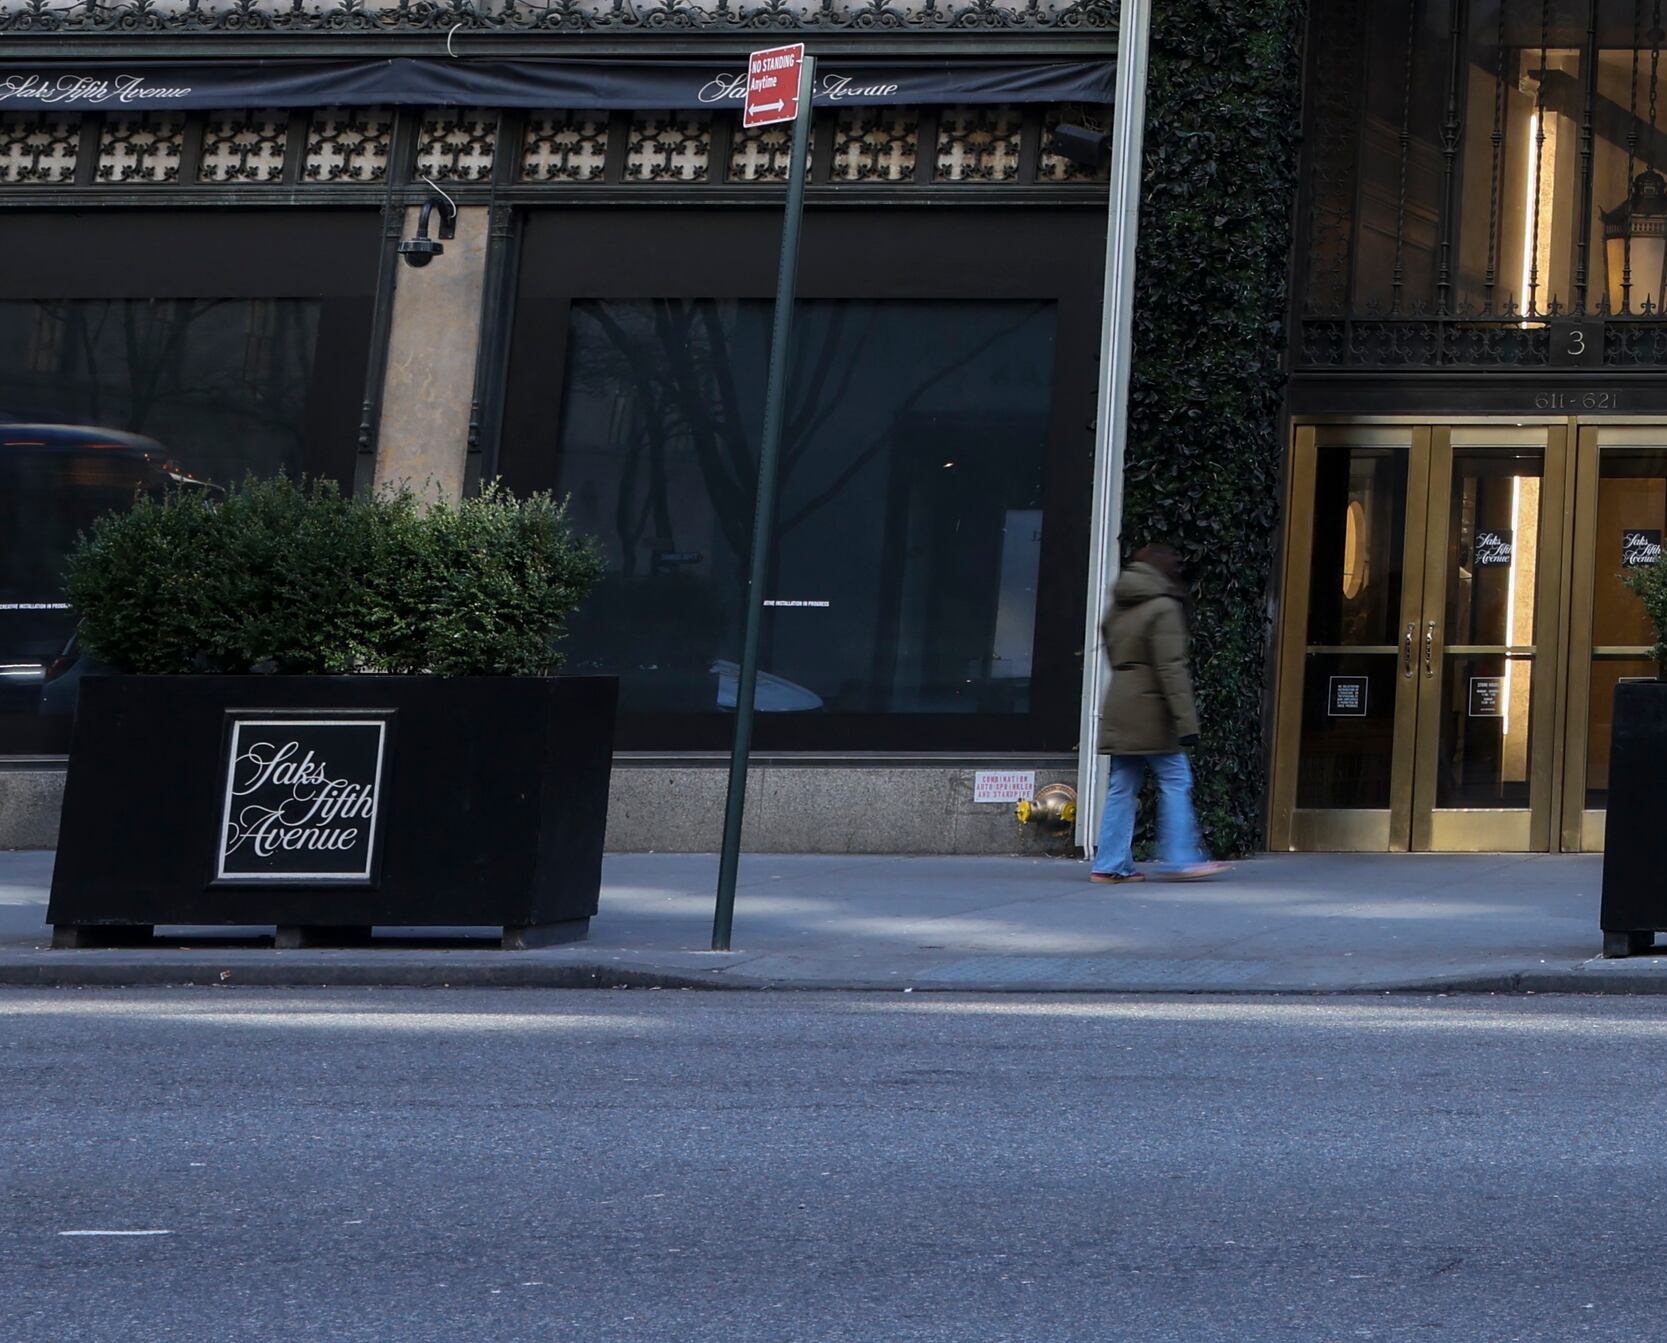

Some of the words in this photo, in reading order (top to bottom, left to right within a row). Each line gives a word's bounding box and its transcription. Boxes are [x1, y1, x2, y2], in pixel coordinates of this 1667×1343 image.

[751, 60, 762, 74] NO
[762, 54, 795, 72] STANDING
[0, 74, 56, 102] Saks
[41, 74, 108, 103] Fifth
[89, 74, 192, 103] Avenue
[750, 75, 777, 92] Anytime
[1567, 330, 1585, 355] 3
[1475, 533, 1501, 548] Saks
[1623, 533, 1649, 549] Saks
[231, 741, 327, 795] Saks
[279, 776, 374, 827] Fifth
[225, 805, 358, 857] Avenue
